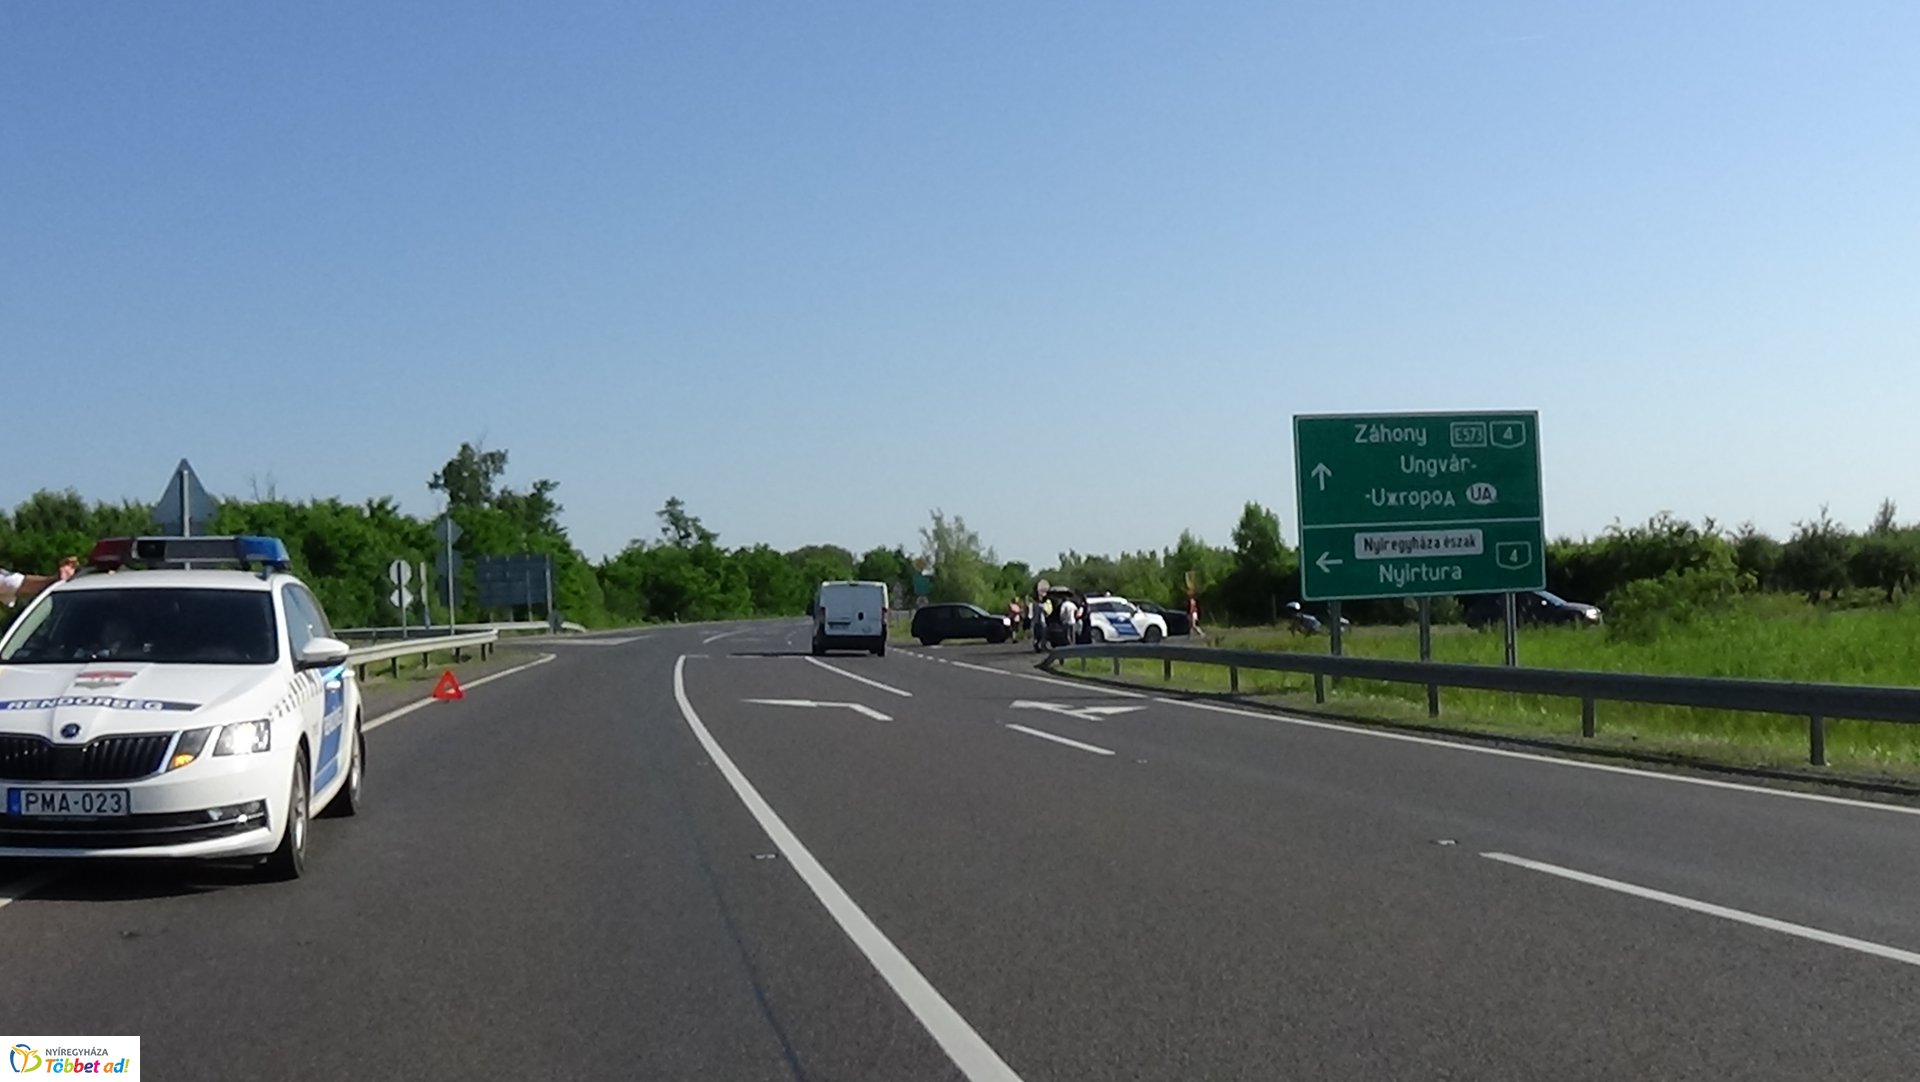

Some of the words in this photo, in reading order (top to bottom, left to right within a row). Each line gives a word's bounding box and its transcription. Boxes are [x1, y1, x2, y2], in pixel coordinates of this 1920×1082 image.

[1354, 424, 1427, 446] Záhony
[1454, 427, 1484, 442] E573
[1503, 427, 1513, 440] 4
[1400, 453, 1477, 478] Ungvár-
[1470, 486, 1492, 500] UA
[1443, 534, 1476, 548] észak
[1509, 549, 1518, 563] 4
[25, 793, 122, 813] PMA-023
